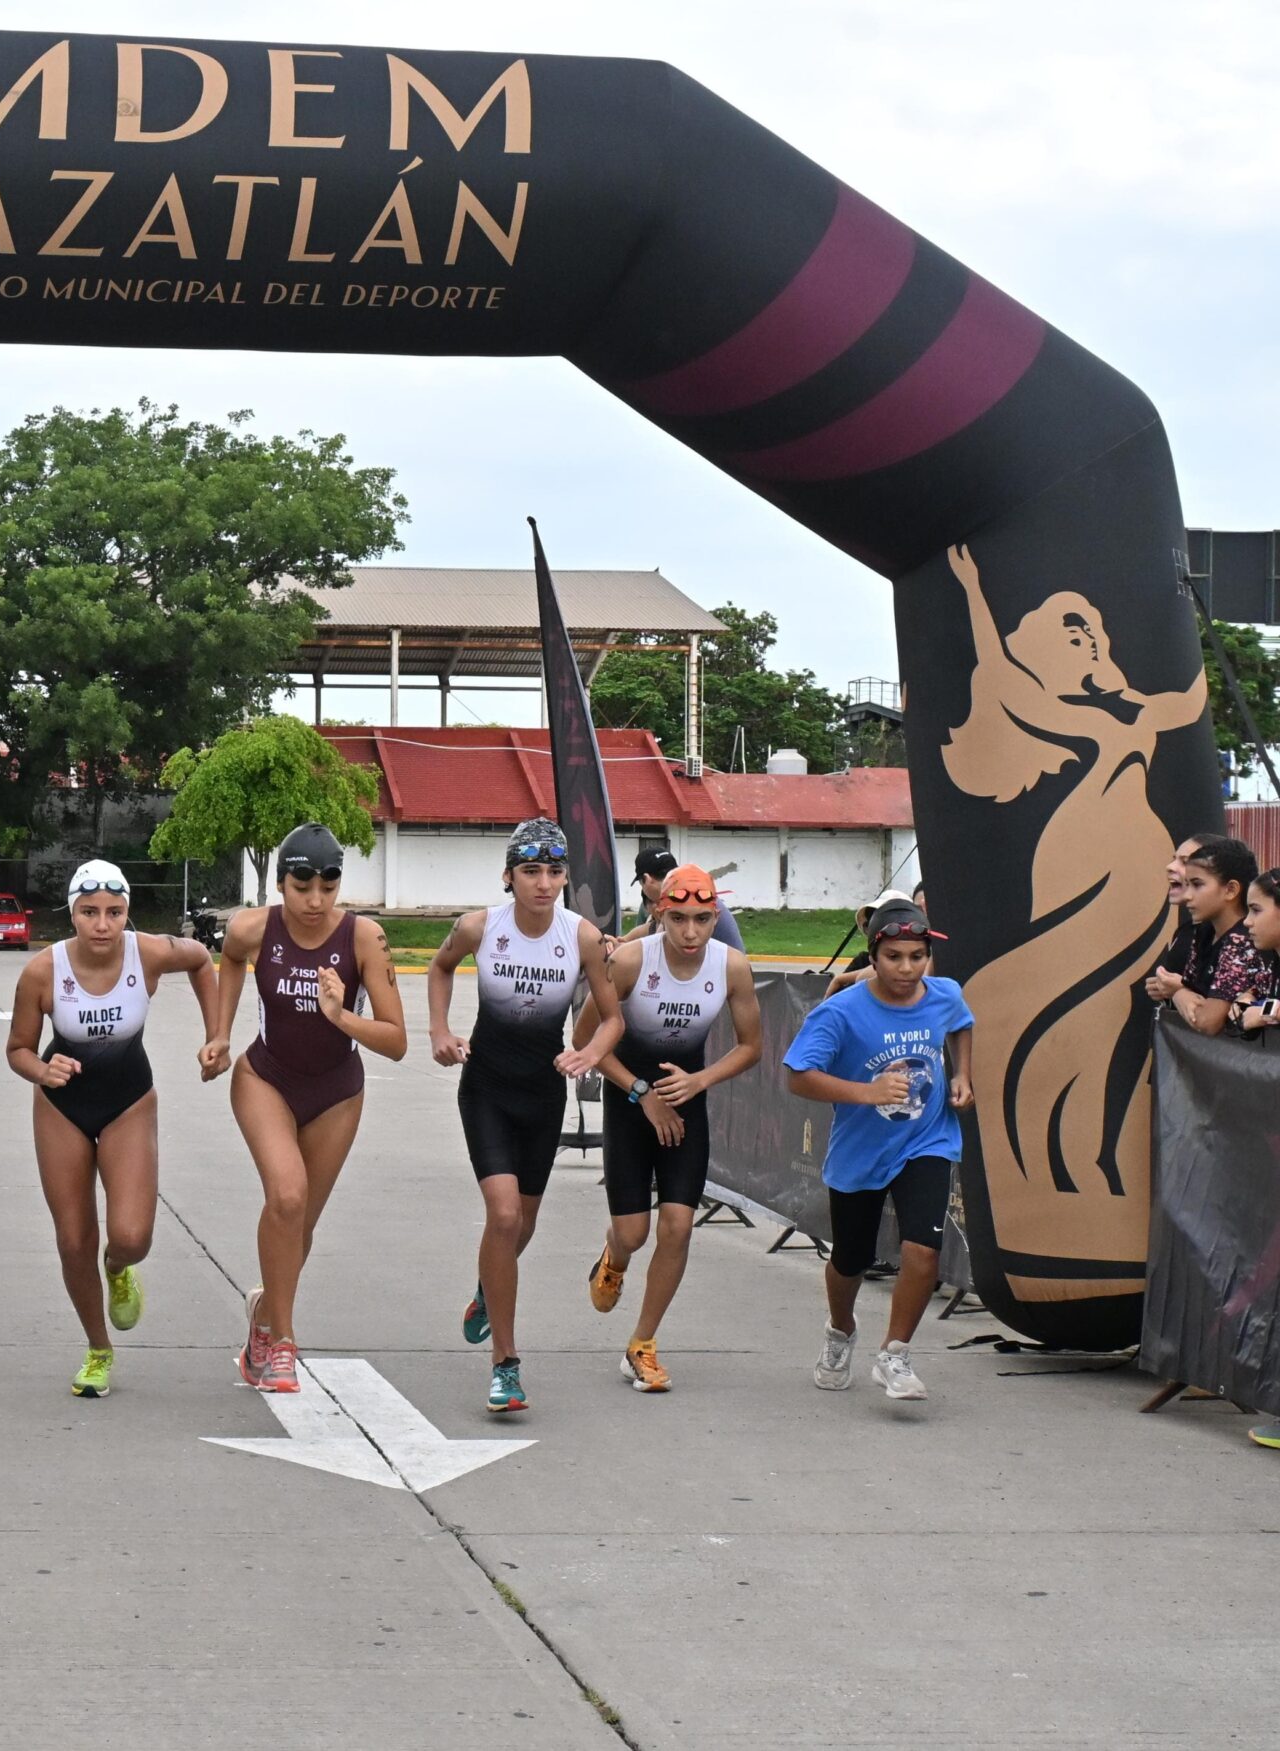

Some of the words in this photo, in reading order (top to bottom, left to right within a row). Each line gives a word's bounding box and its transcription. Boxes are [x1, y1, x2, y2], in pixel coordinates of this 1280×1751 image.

[43, 277, 246, 305] MUNICIPAL
[263, 283, 324, 307] DEL
[342, 285, 506, 310] DEPORTE
[299, 968, 318, 979] ISD
[493, 962, 566, 983] SANTAMARIA
[276, 978, 320, 998] ALARD
[514, 981, 543, 996] MAZ
[295, 998, 317, 1013] SIN
[657, 1001, 701, 1017] PINEDA
[78, 1006, 123, 1024] VALDEZ
[87, 1024, 115, 1037] MAZ
[663, 1018, 691, 1029] MAZ
[883, 1032, 896, 1044] MY
[900, 1029, 930, 1042] WORLD
[865, 1044, 907, 1071] REVOLVES
